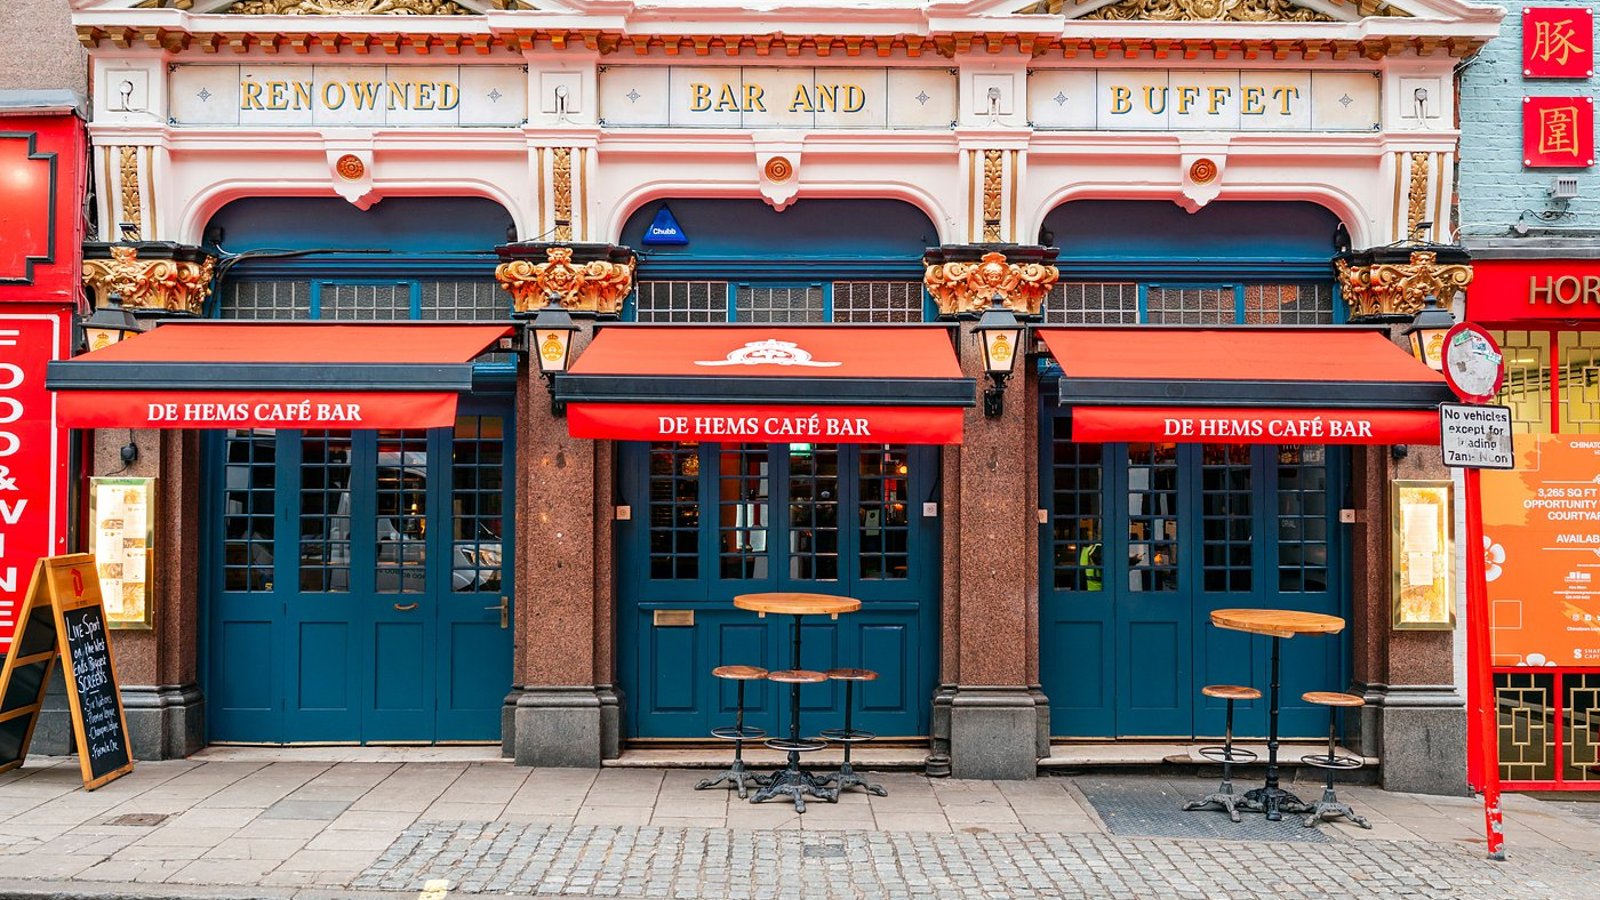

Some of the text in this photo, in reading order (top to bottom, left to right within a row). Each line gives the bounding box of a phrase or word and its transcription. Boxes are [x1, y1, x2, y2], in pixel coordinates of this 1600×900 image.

[1530, 19, 1586, 66] 豚
[240, 79, 460, 110] RENOWNED
[690, 83, 866, 112] BAR AND
[1110, 85, 1299, 115] BUFFET
[1538, 106, 1579, 157] 圍
[652, 227, 677, 235] Chubb
[1529, 275, 1600, 305] HOR
[147, 399, 362, 421] DE HEMS CAFÉ BAR
[1444, 409, 1507, 422] No vehicles
[658, 413, 871, 436] DE HEMS CAFÉ BAR
[1164, 415, 1373, 437] DE HEMS CAFÉ BAR
[1449, 425, 1503, 436] except for
[1457, 437, 1497, 451] lading
[1523, 499, 1598, 509] OPPORTUNITY
[1537, 488, 1597, 499] 3,265 SQ FT
